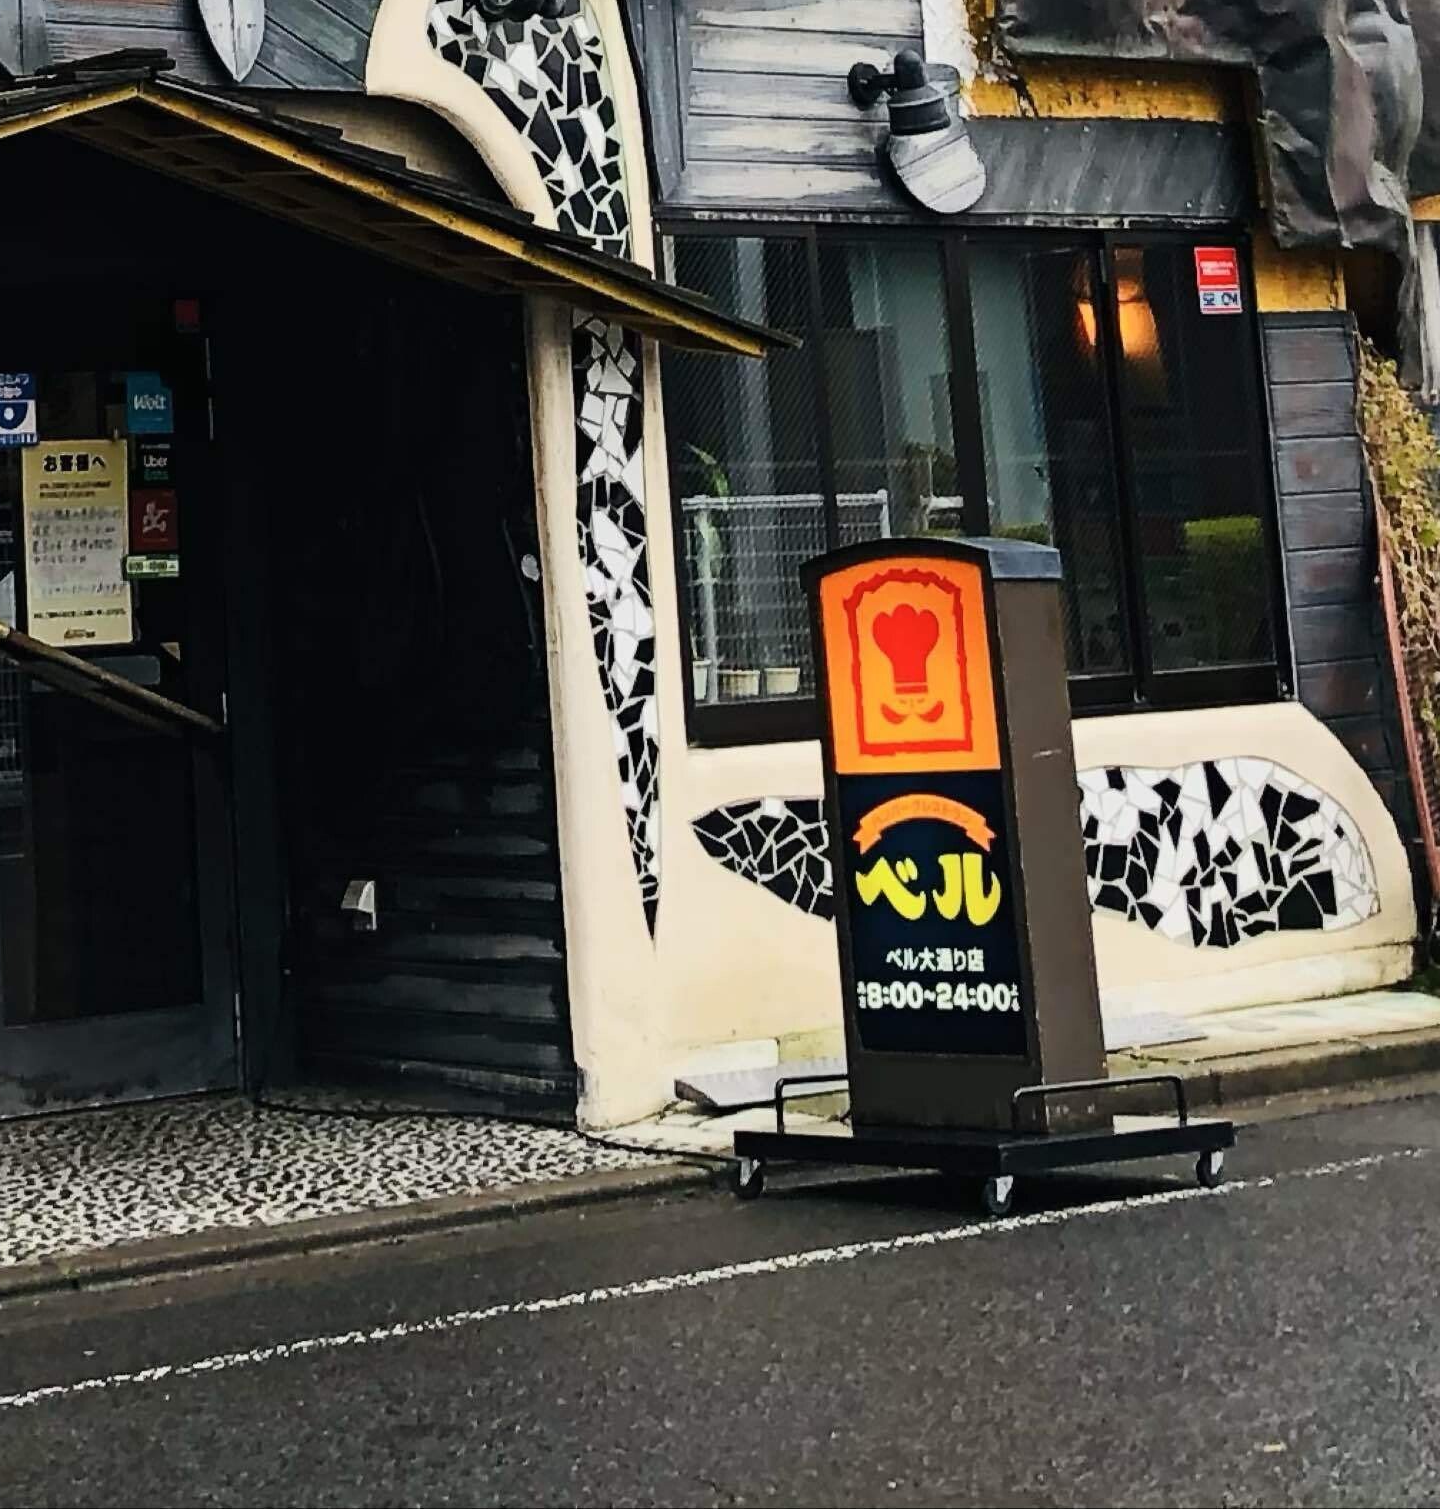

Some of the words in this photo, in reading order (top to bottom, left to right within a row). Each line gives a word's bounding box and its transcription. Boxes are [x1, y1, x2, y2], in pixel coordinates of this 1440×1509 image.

[855, 852, 1001, 927] ベル
[886, 946, 985, 972] ベル大通り店
